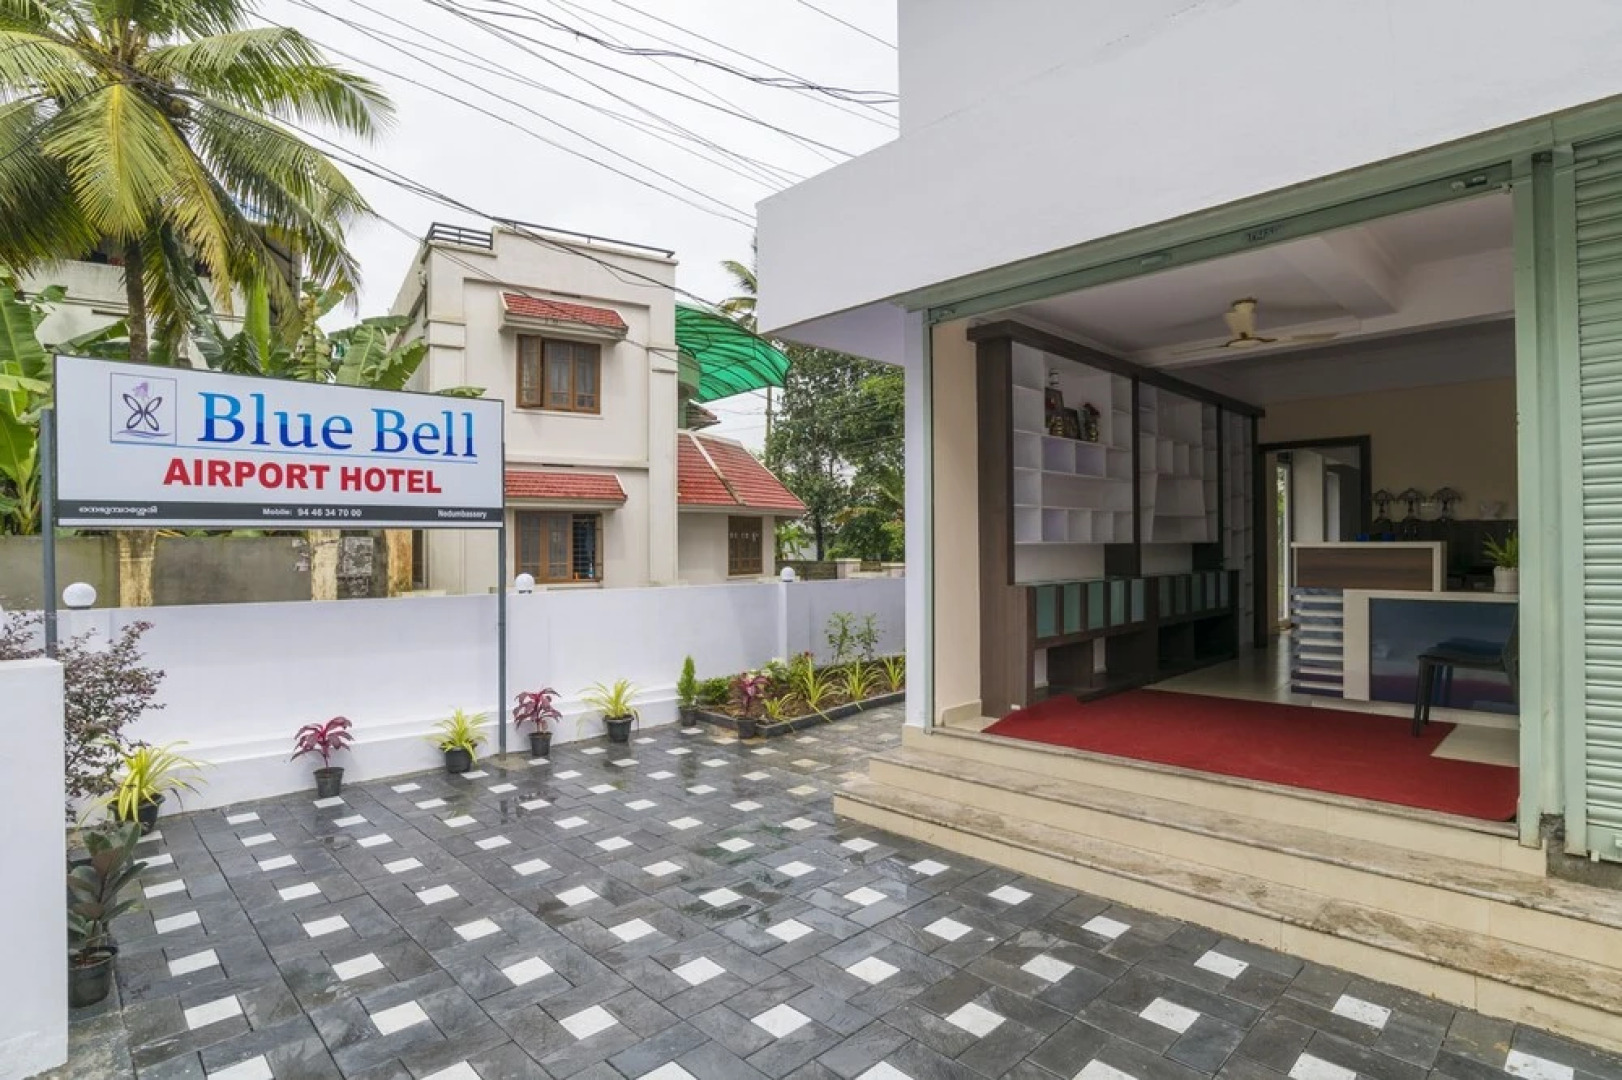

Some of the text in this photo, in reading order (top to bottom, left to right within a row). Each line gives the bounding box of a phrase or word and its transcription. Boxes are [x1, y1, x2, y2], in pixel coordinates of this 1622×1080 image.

[197, 390, 479, 459] Blue Bell
[163, 458, 442, 494] AIRPORT HOTEL
[297, 508, 309, 517] 94
[325, 508, 336, 517] 34
[338, 508, 349, 517] 70
[350, 509, 363, 518] 00
